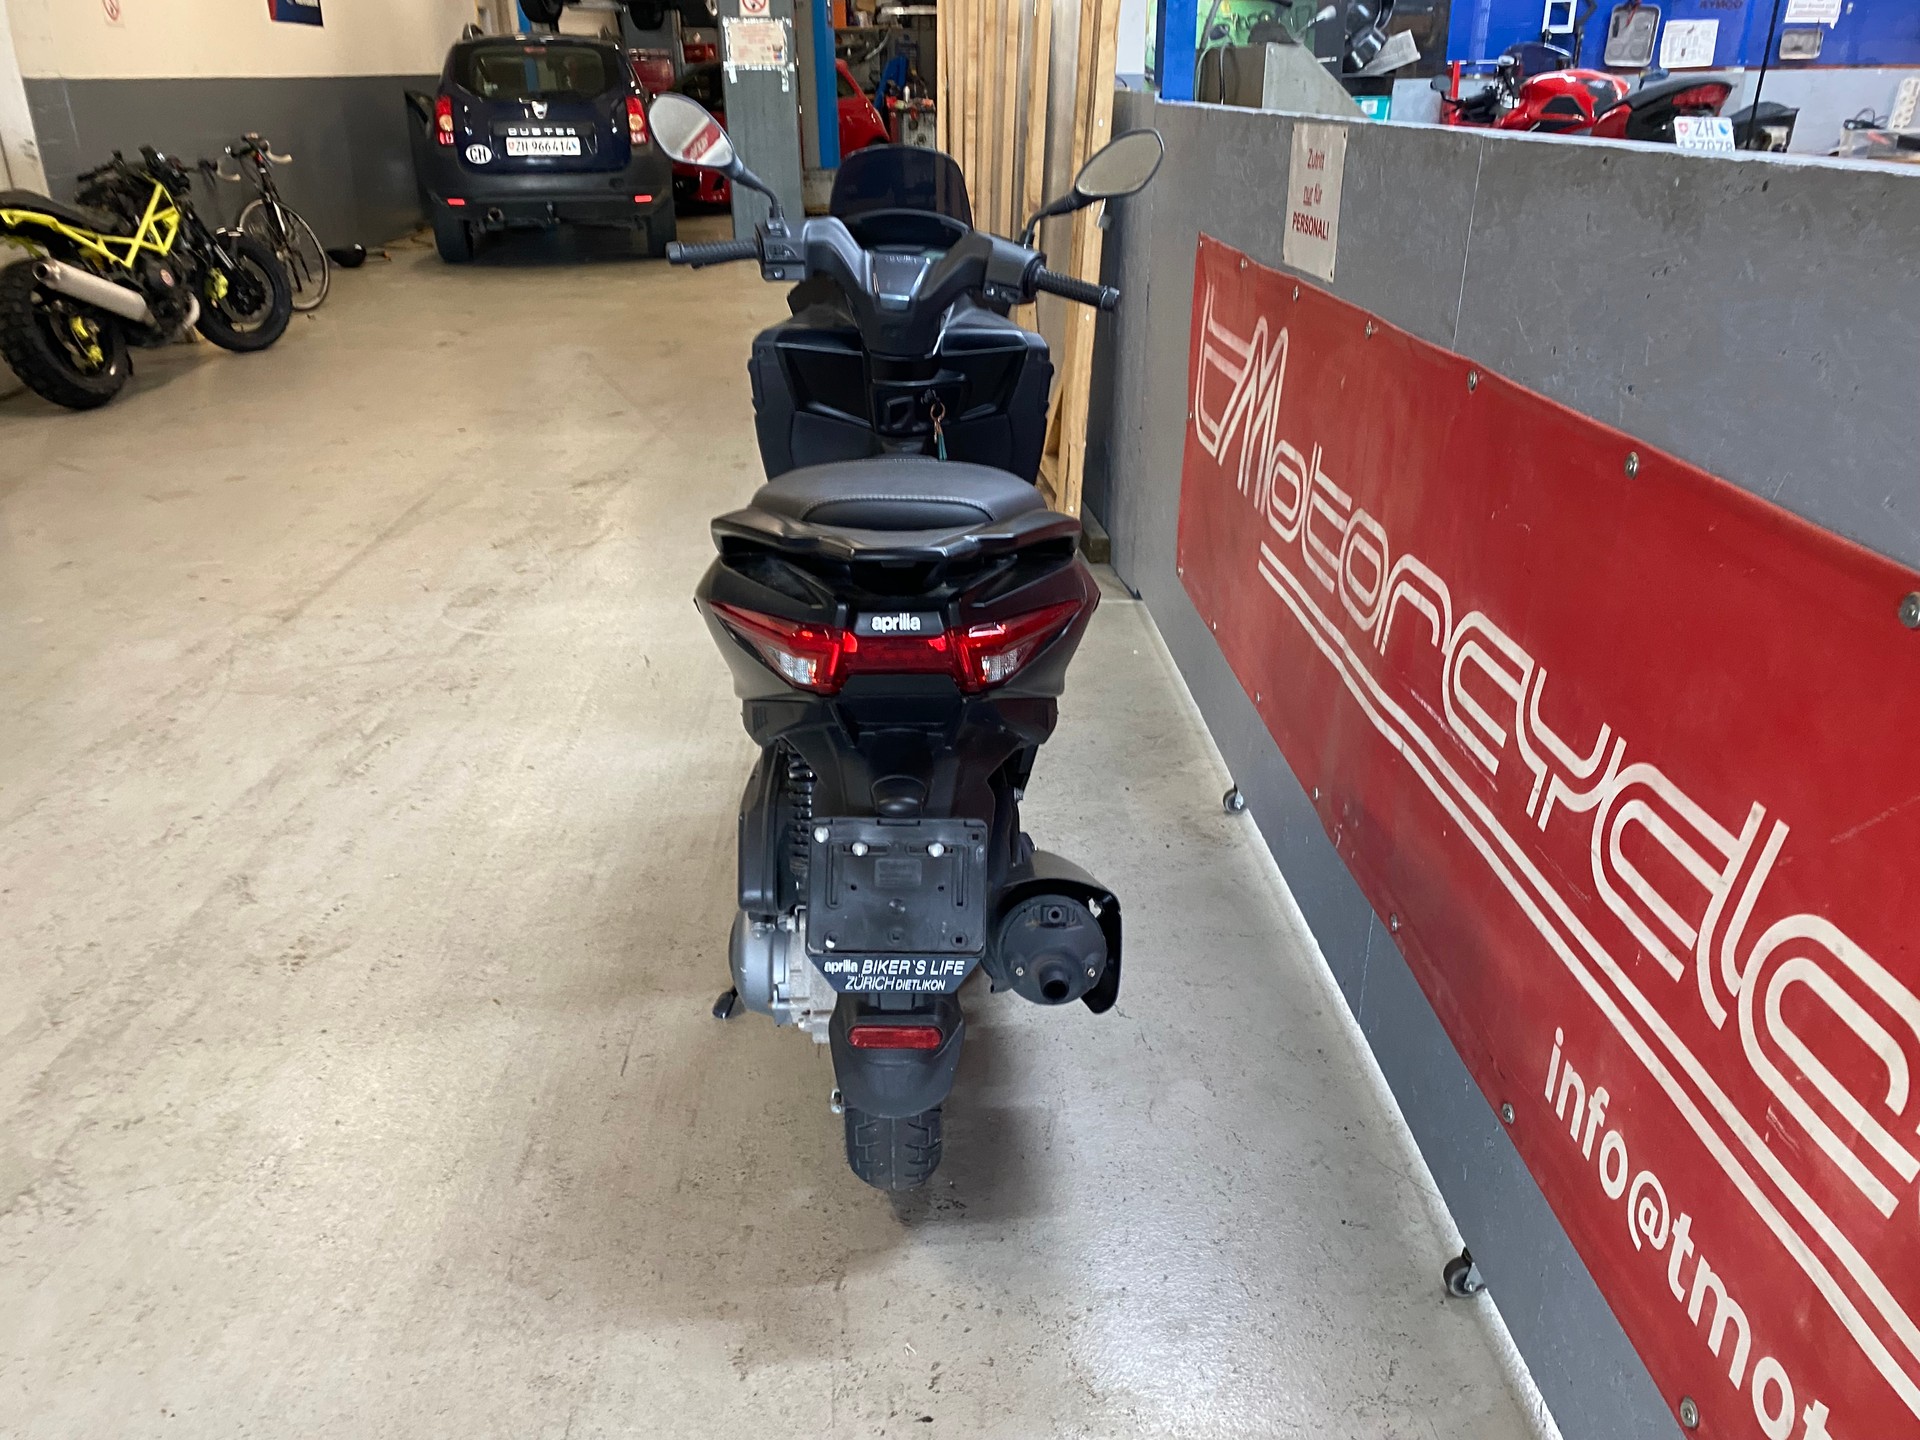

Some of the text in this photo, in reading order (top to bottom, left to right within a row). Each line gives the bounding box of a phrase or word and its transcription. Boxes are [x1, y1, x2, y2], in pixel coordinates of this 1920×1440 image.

[508, 127, 576, 136] DUSTER
[1696, 119, 1714, 138] ZH
[469, 147, 488, 163] CH
[516, 140, 572, 154] ZH 966414
[1303, 183, 1323, 206] nur für
[871, 612, 921, 634] aprilia
[824, 960, 858, 974] aprilia
[930, 960, 965, 976] LIFE
[845, 974, 946, 991] ZÜRICH DIETLIKON
